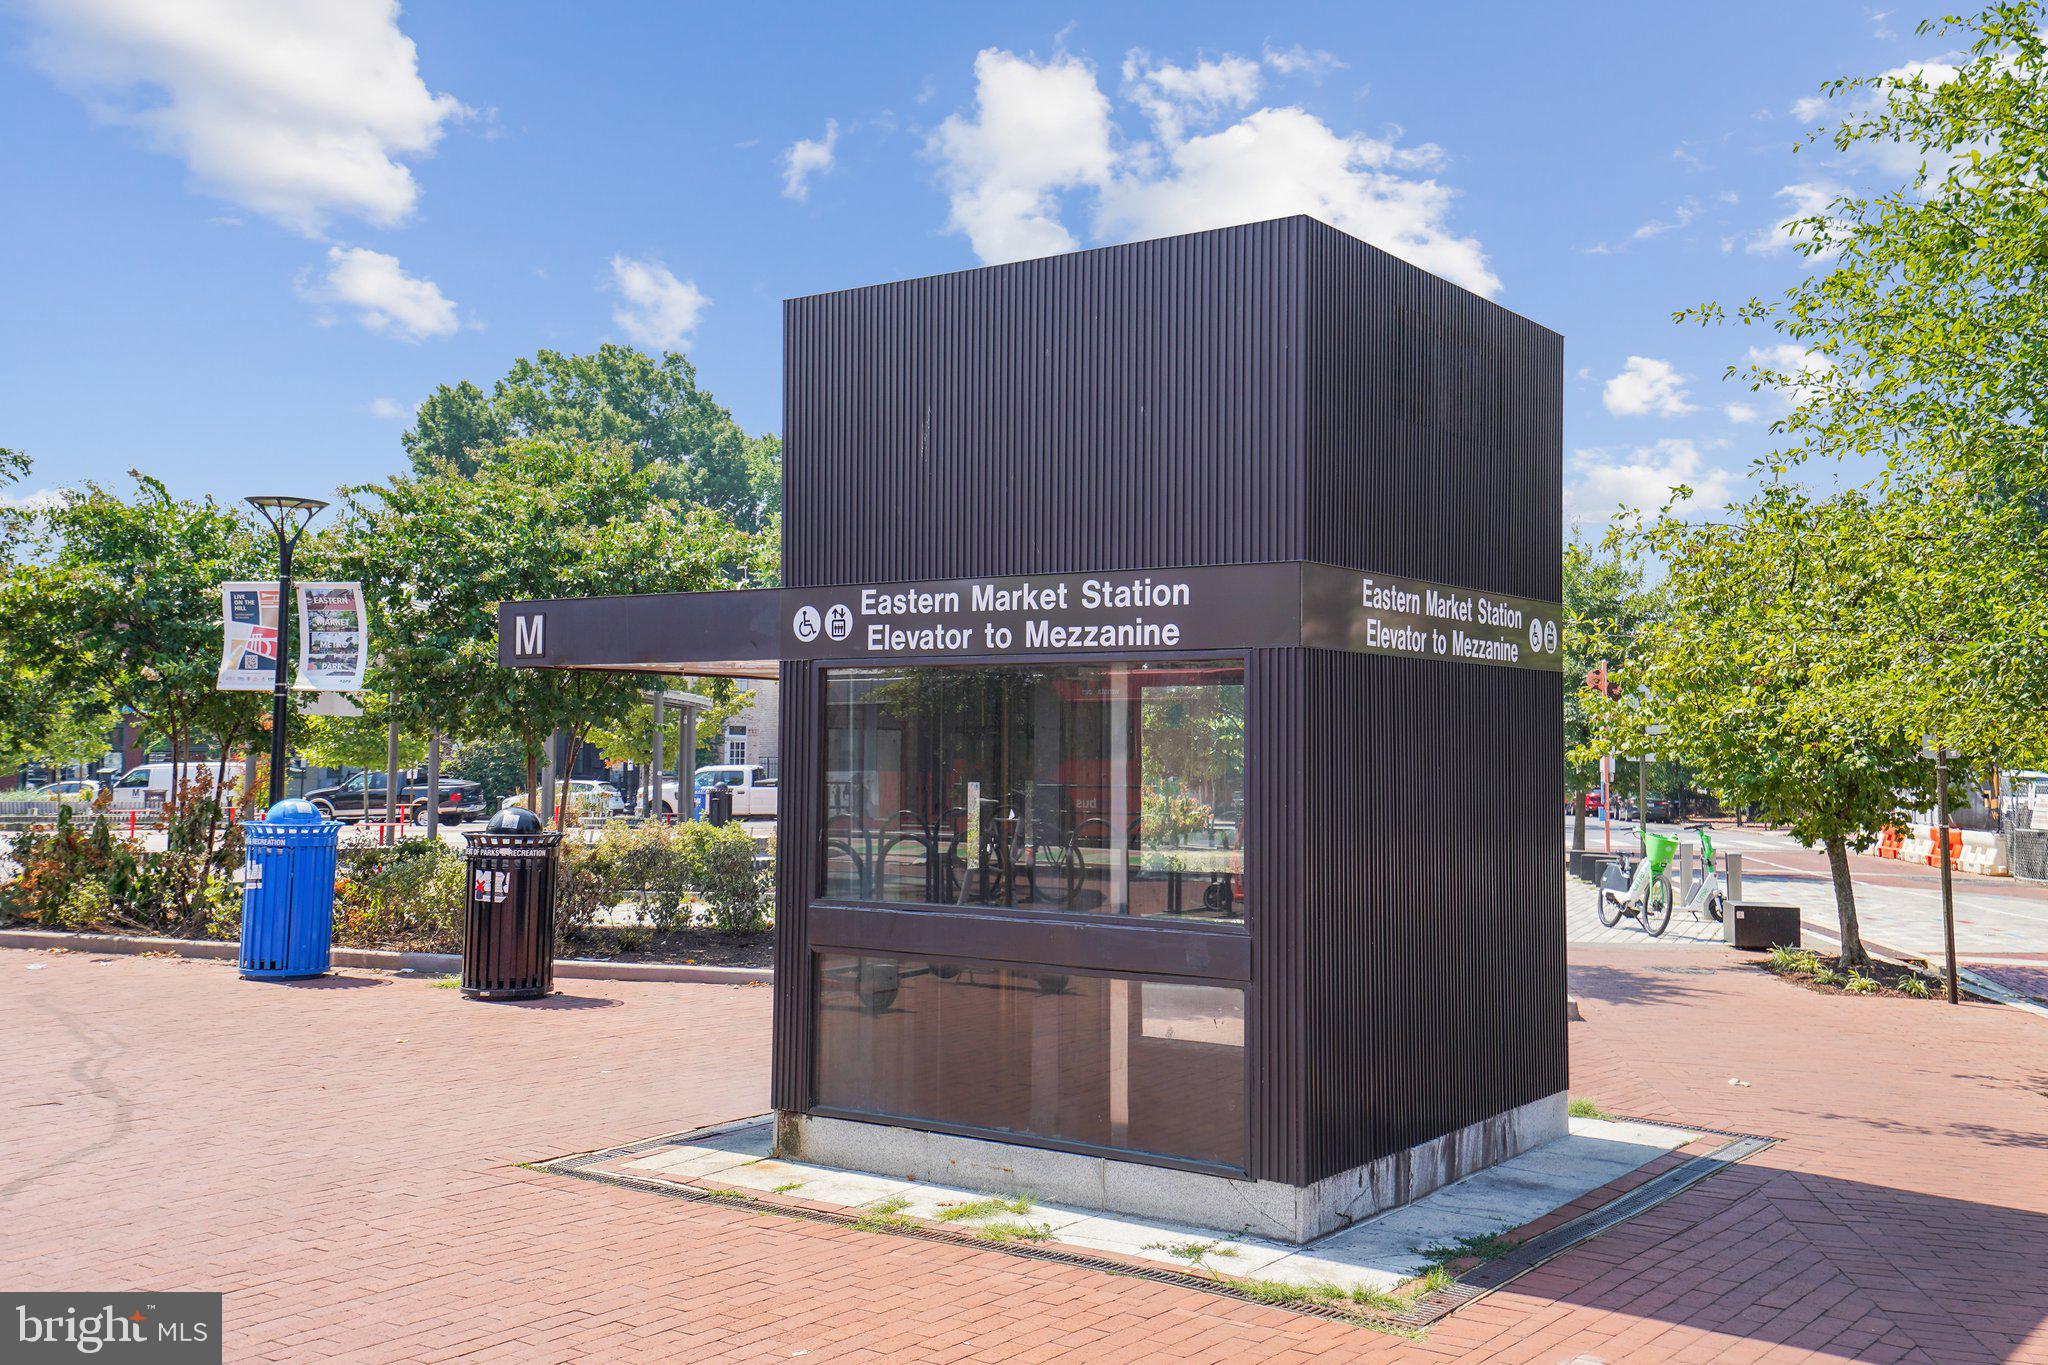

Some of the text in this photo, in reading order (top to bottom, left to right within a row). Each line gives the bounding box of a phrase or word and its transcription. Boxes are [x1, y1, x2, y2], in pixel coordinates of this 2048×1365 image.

[313, 596, 349, 604] EASTERN
[861, 579, 1190, 615] Eastern Market Station
[1362, 578, 1522, 629] Eastern Market Station
[316, 618, 350, 626] MARKET
[515, 615, 543, 655] M
[867, 618, 1180, 650] Elevator to Mezzanine
[1366, 618, 1518, 663] Elevator to Mezzanine
[319, 641, 348, 649] METRO
[321, 662, 343, 670] PARK
[252, 838, 286, 846] RECREATION
[480, 849, 499, 857] PARKS
